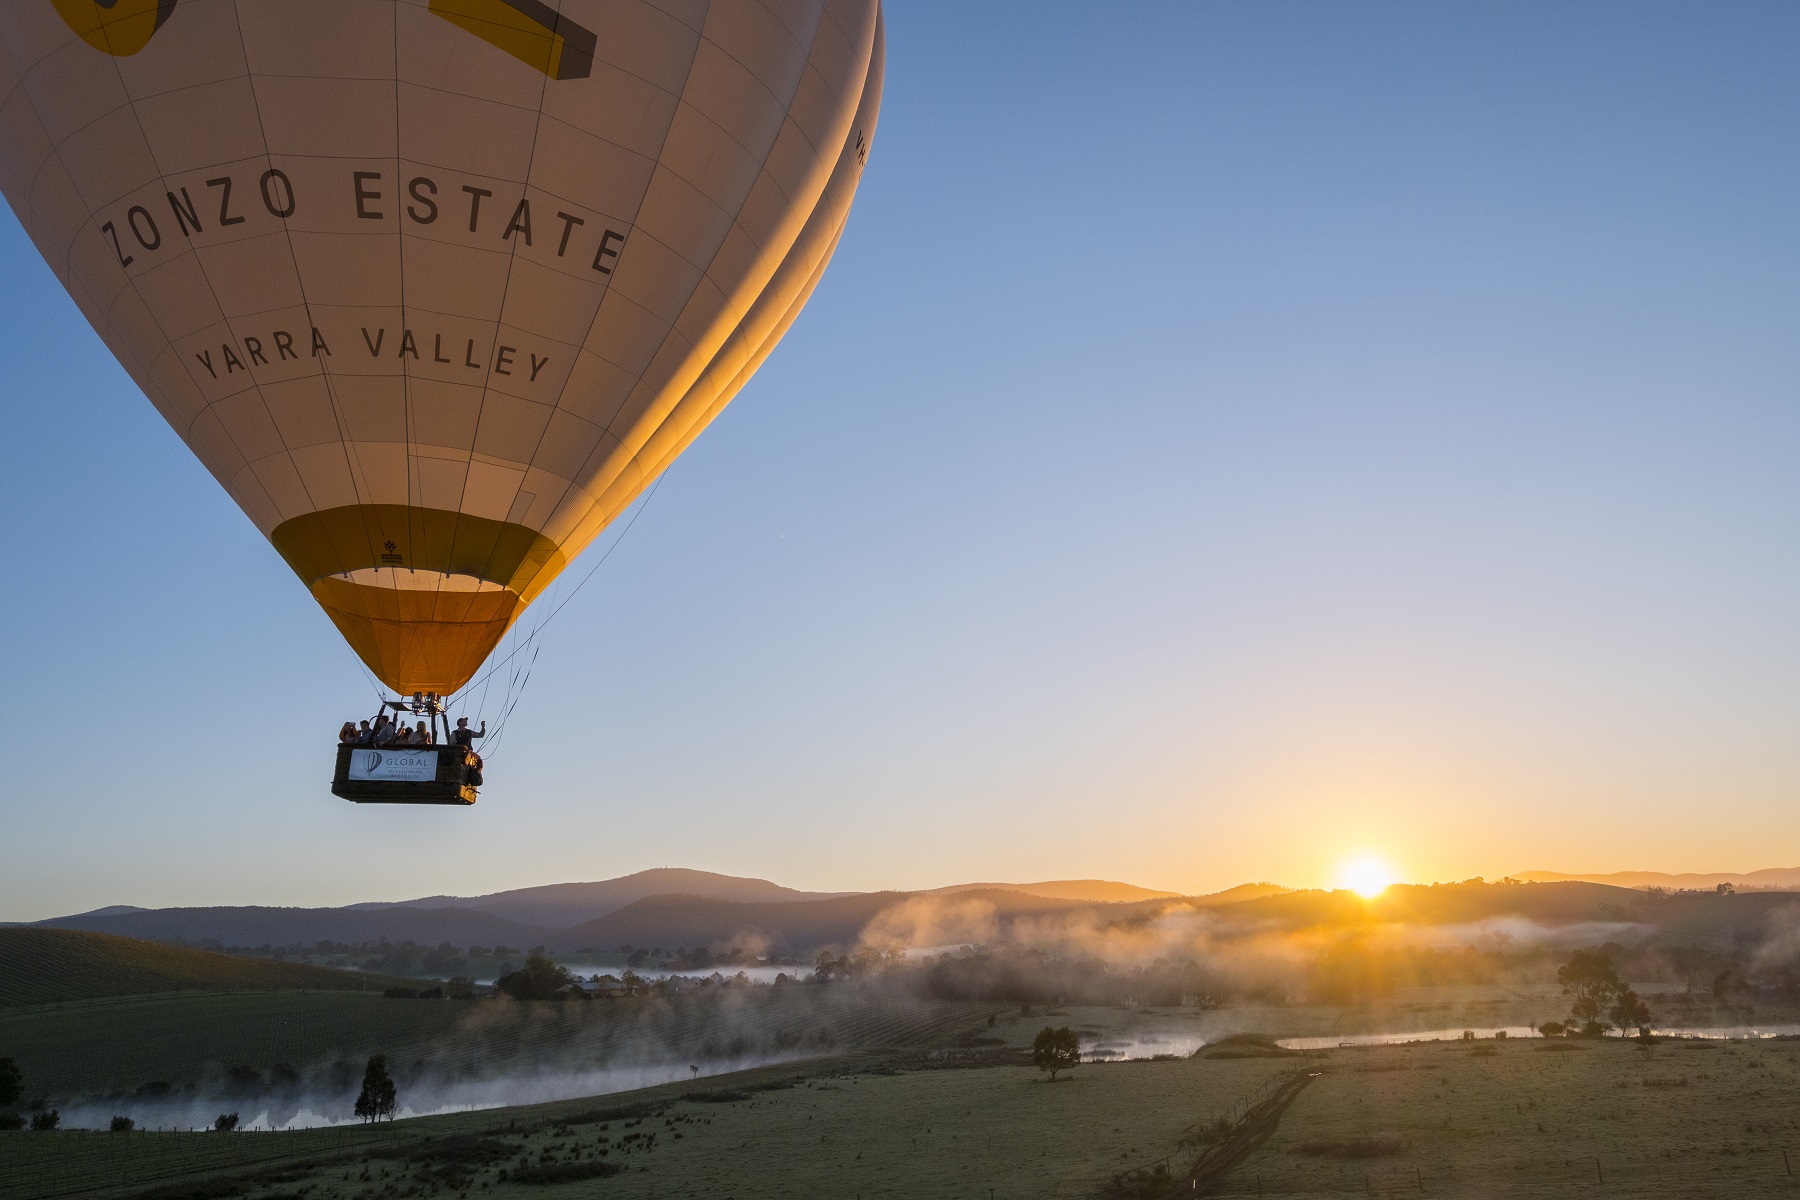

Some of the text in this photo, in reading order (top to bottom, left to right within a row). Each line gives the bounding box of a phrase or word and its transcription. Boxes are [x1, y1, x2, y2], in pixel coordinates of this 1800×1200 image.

[101, 168, 625, 275] ZONZO ESTATE
[195, 327, 549, 382] YARRA VALLEY
[386, 758, 428, 767] GLOBAL
